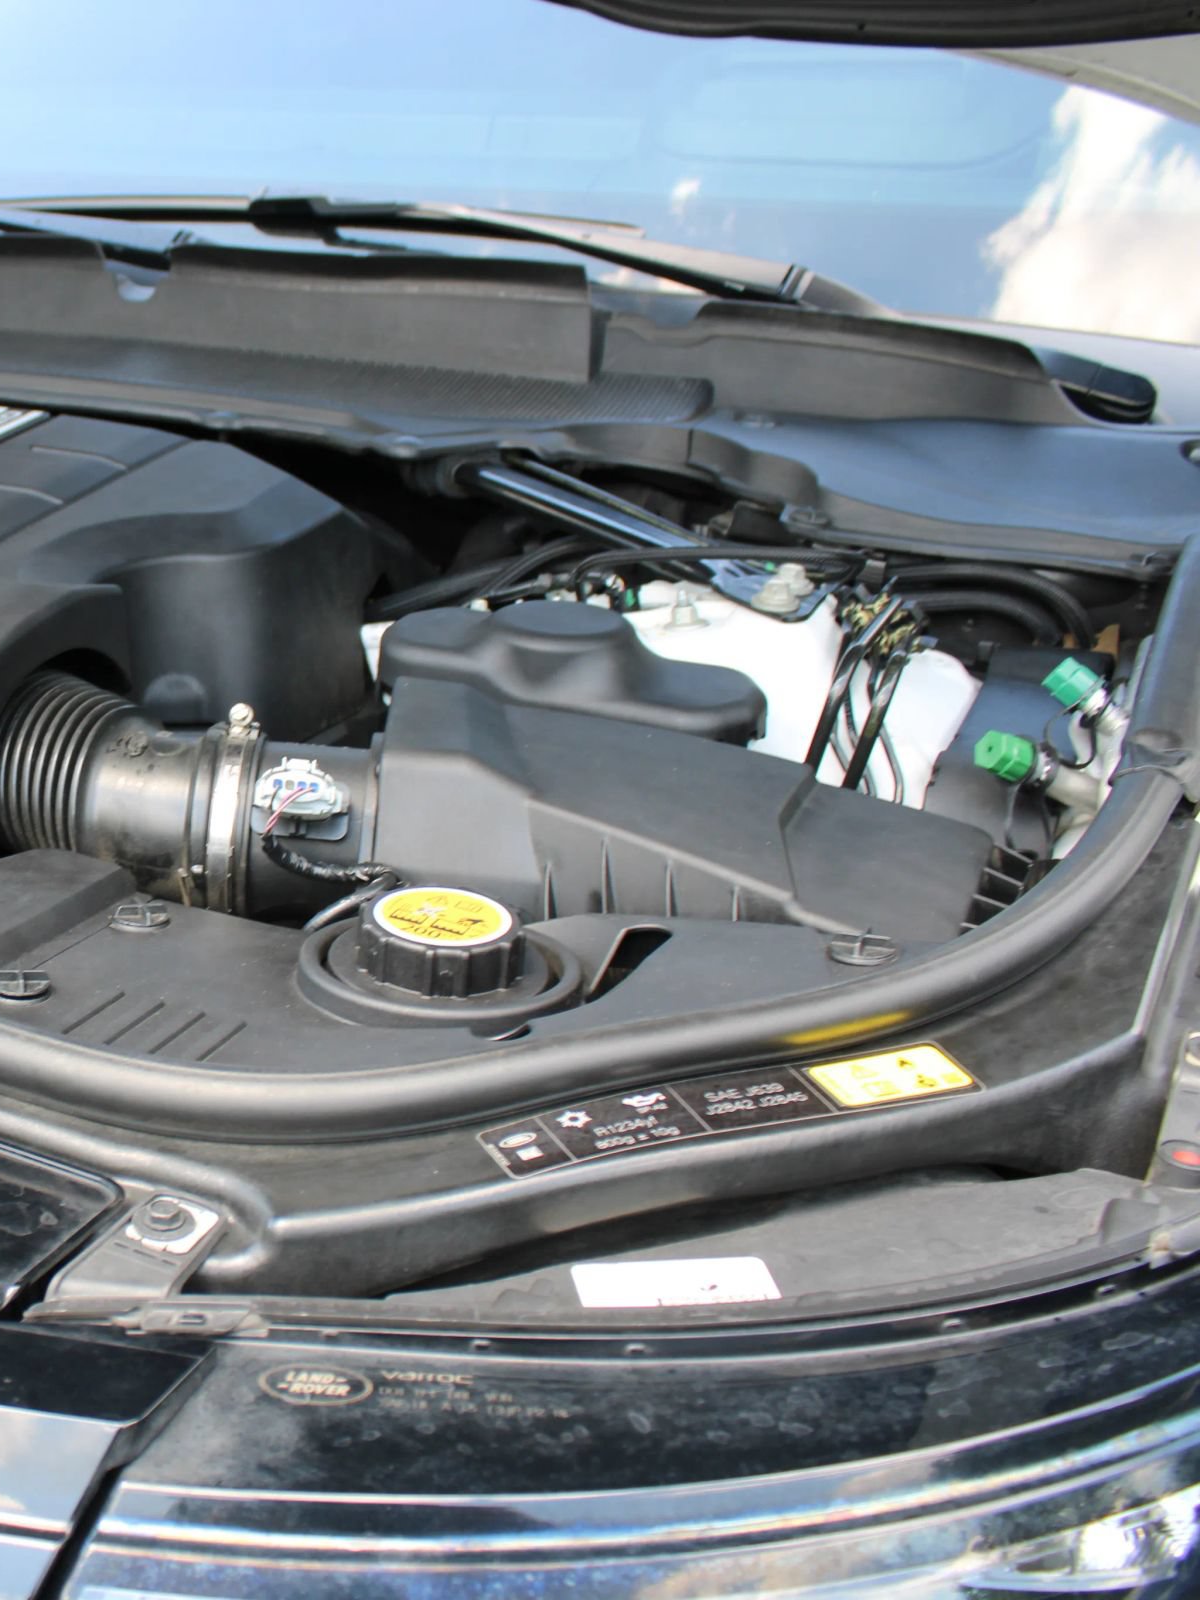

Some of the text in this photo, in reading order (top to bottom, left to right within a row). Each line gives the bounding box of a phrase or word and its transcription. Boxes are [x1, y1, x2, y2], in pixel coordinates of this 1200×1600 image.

[703, 1088, 743, 1102] SAE
[285, 1370, 336, 1384] LAND
[289, 1383, 351, 1397] ROVER
